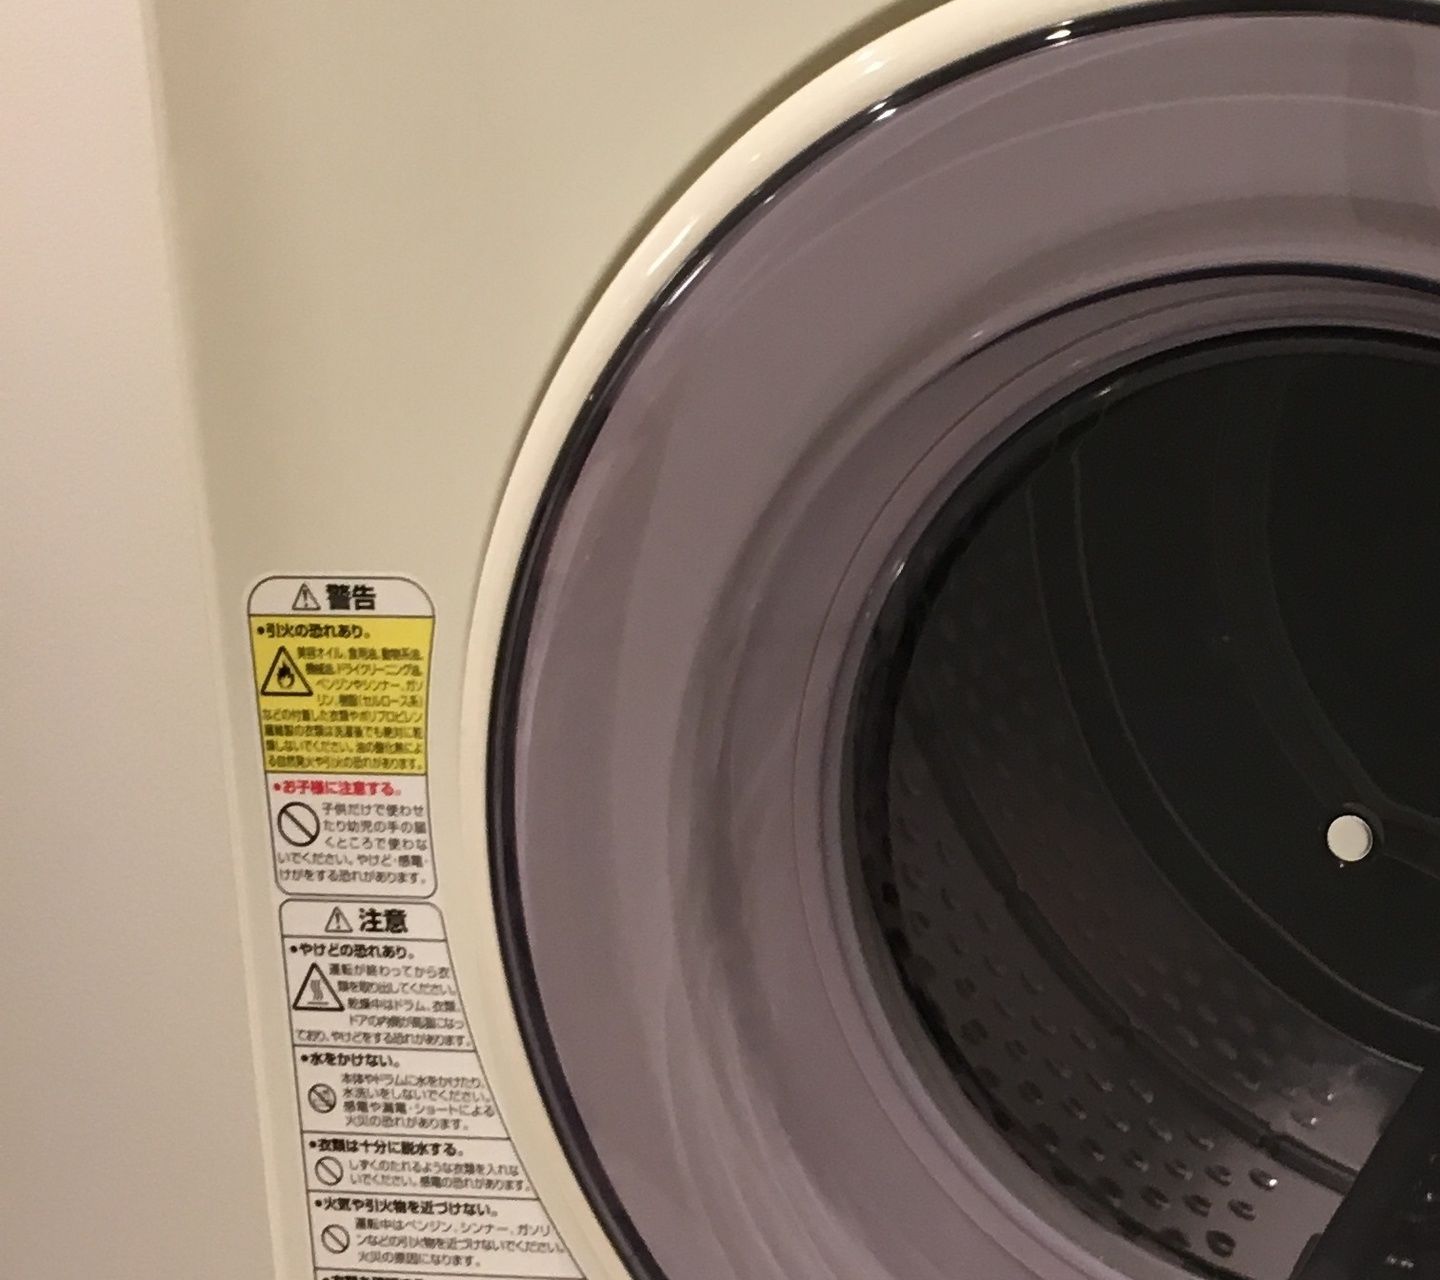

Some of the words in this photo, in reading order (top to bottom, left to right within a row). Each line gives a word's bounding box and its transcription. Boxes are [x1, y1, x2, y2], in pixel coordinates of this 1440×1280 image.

[325, 584, 377, 611] 警告
[265, 622, 371, 640] 引火の恐れあり。
[322, 802, 425, 818] 子供だけで使わせ
[324, 836, 427, 852] くところで使わな
[359, 908, 409, 934] 注意
